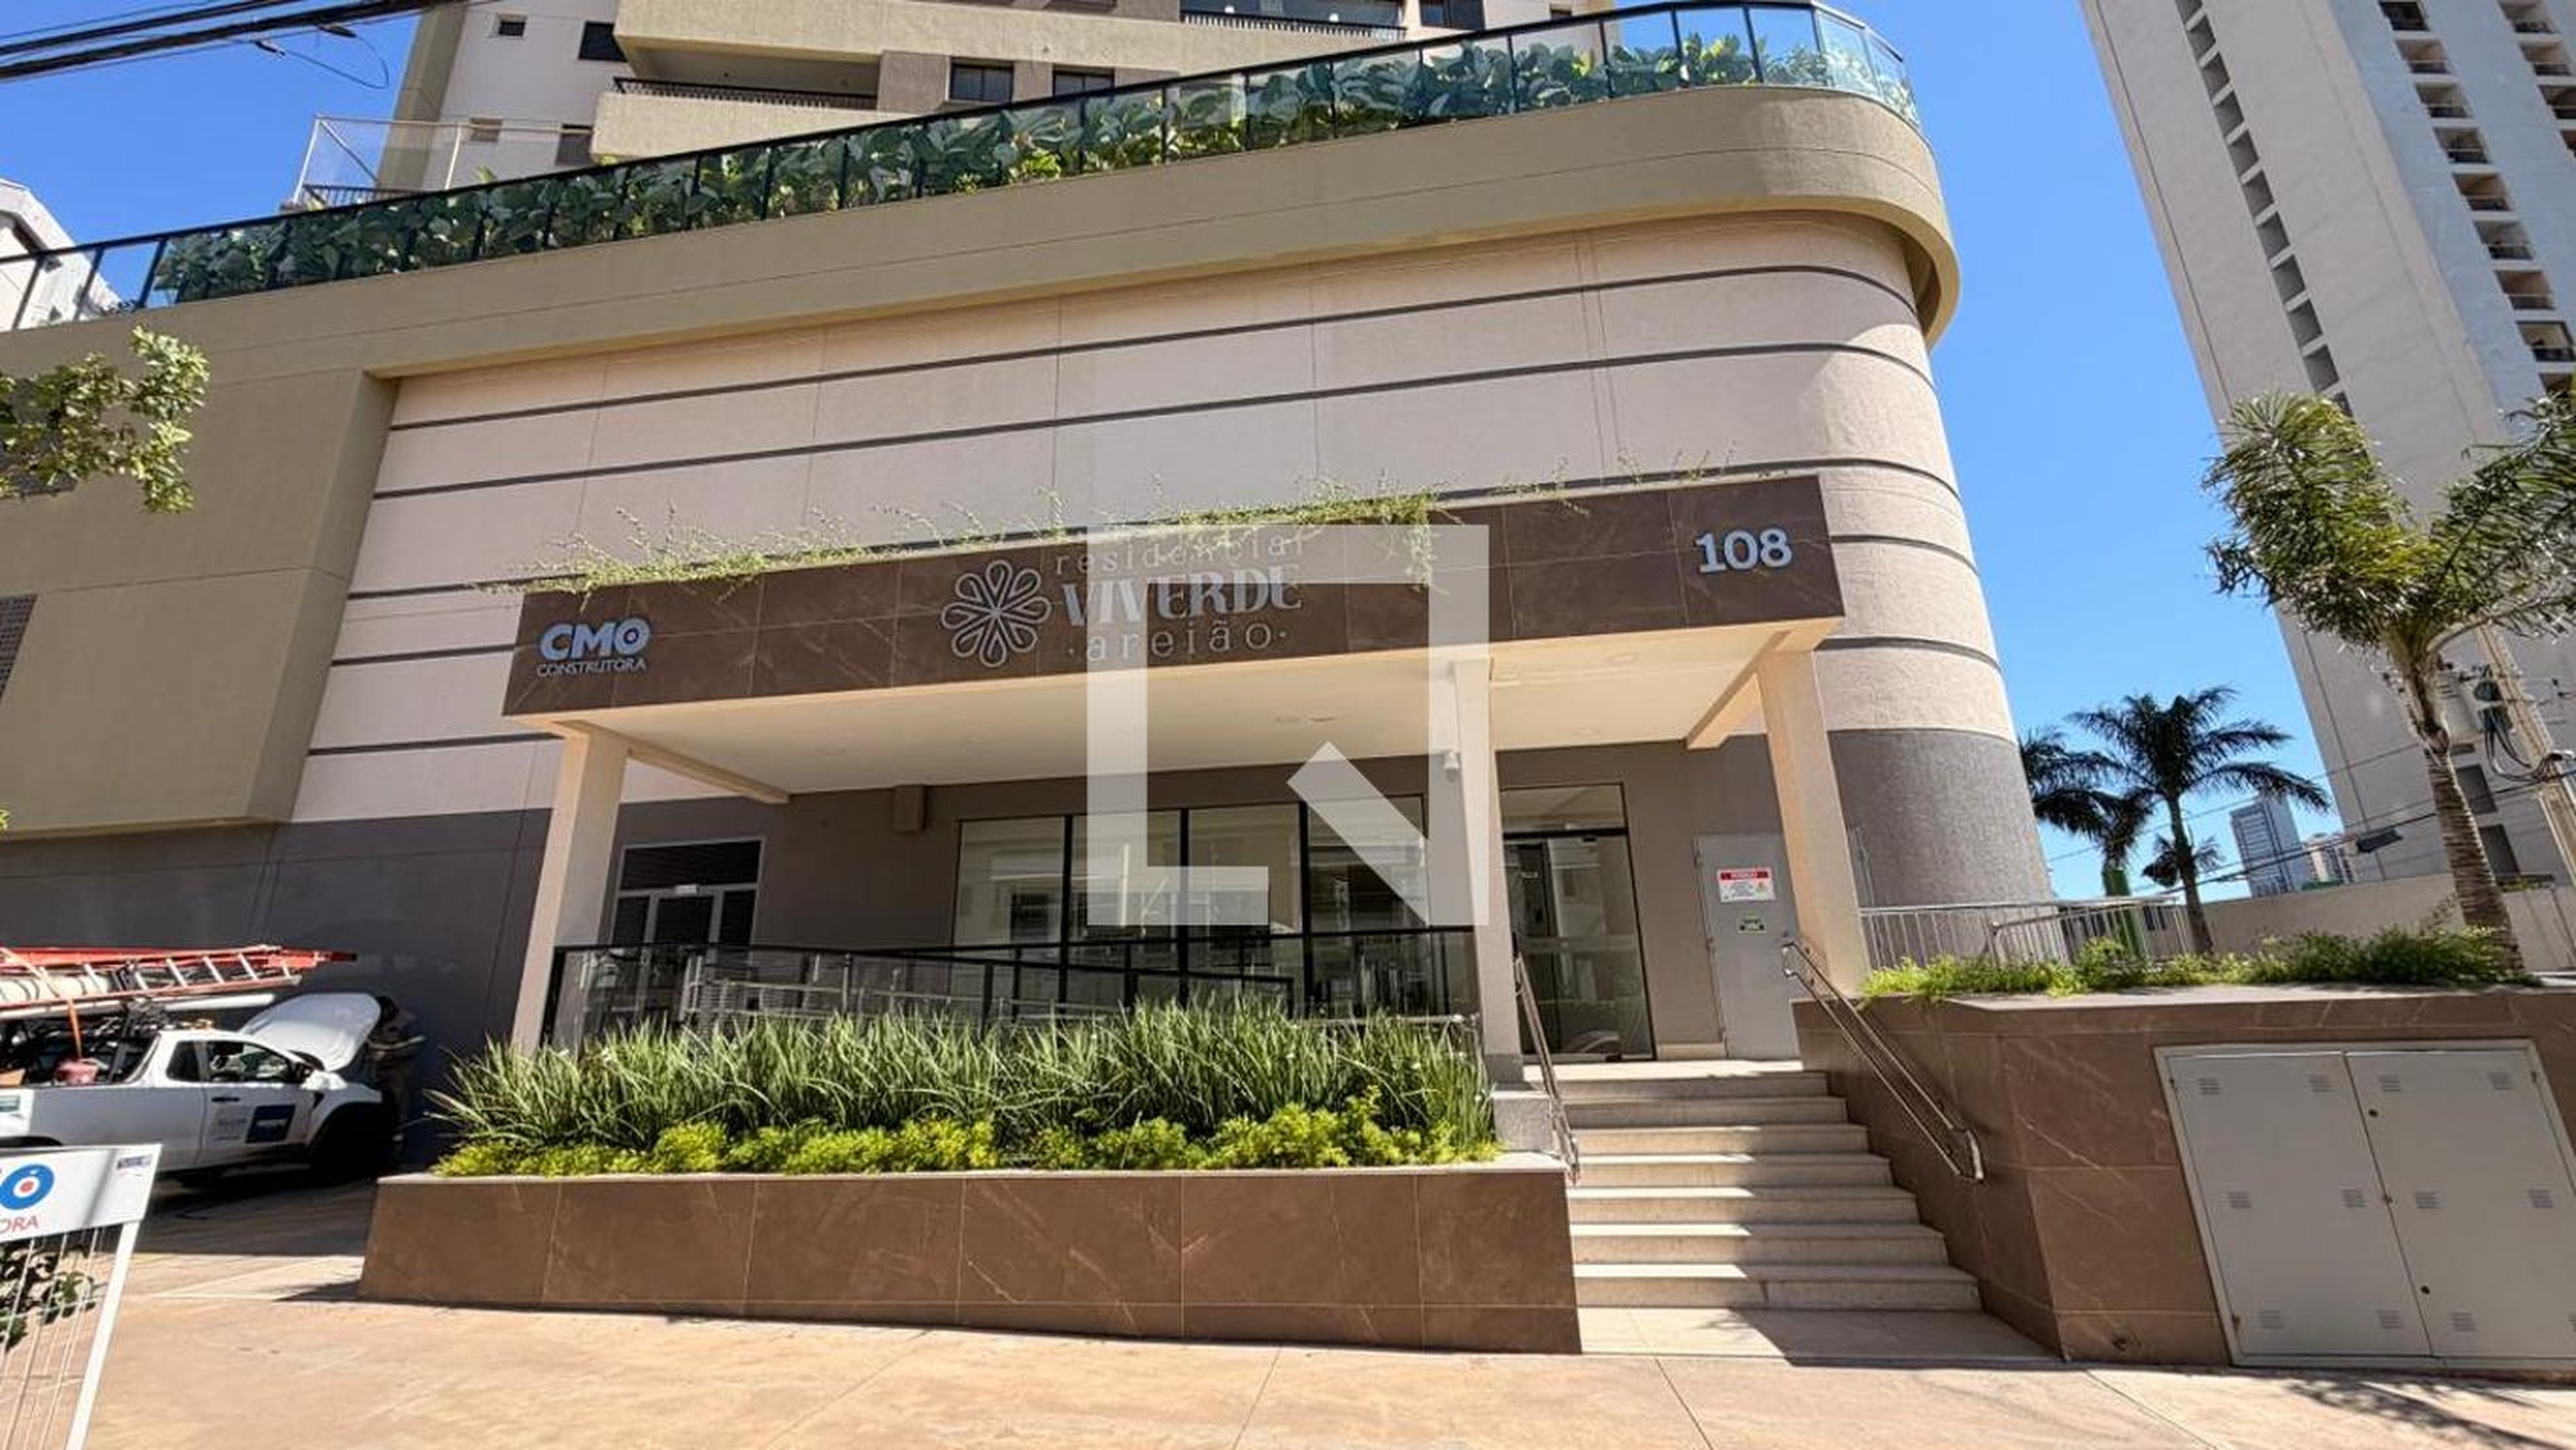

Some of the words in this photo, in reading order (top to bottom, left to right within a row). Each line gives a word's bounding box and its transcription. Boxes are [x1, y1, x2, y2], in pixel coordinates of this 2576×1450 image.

[1696, 527, 1792, 573] 108
[1062, 563, 1302, 627] VIVERDE
[540, 617, 651, 661] CMO
[537, 657, 647, 676] CONSTRUTORA
